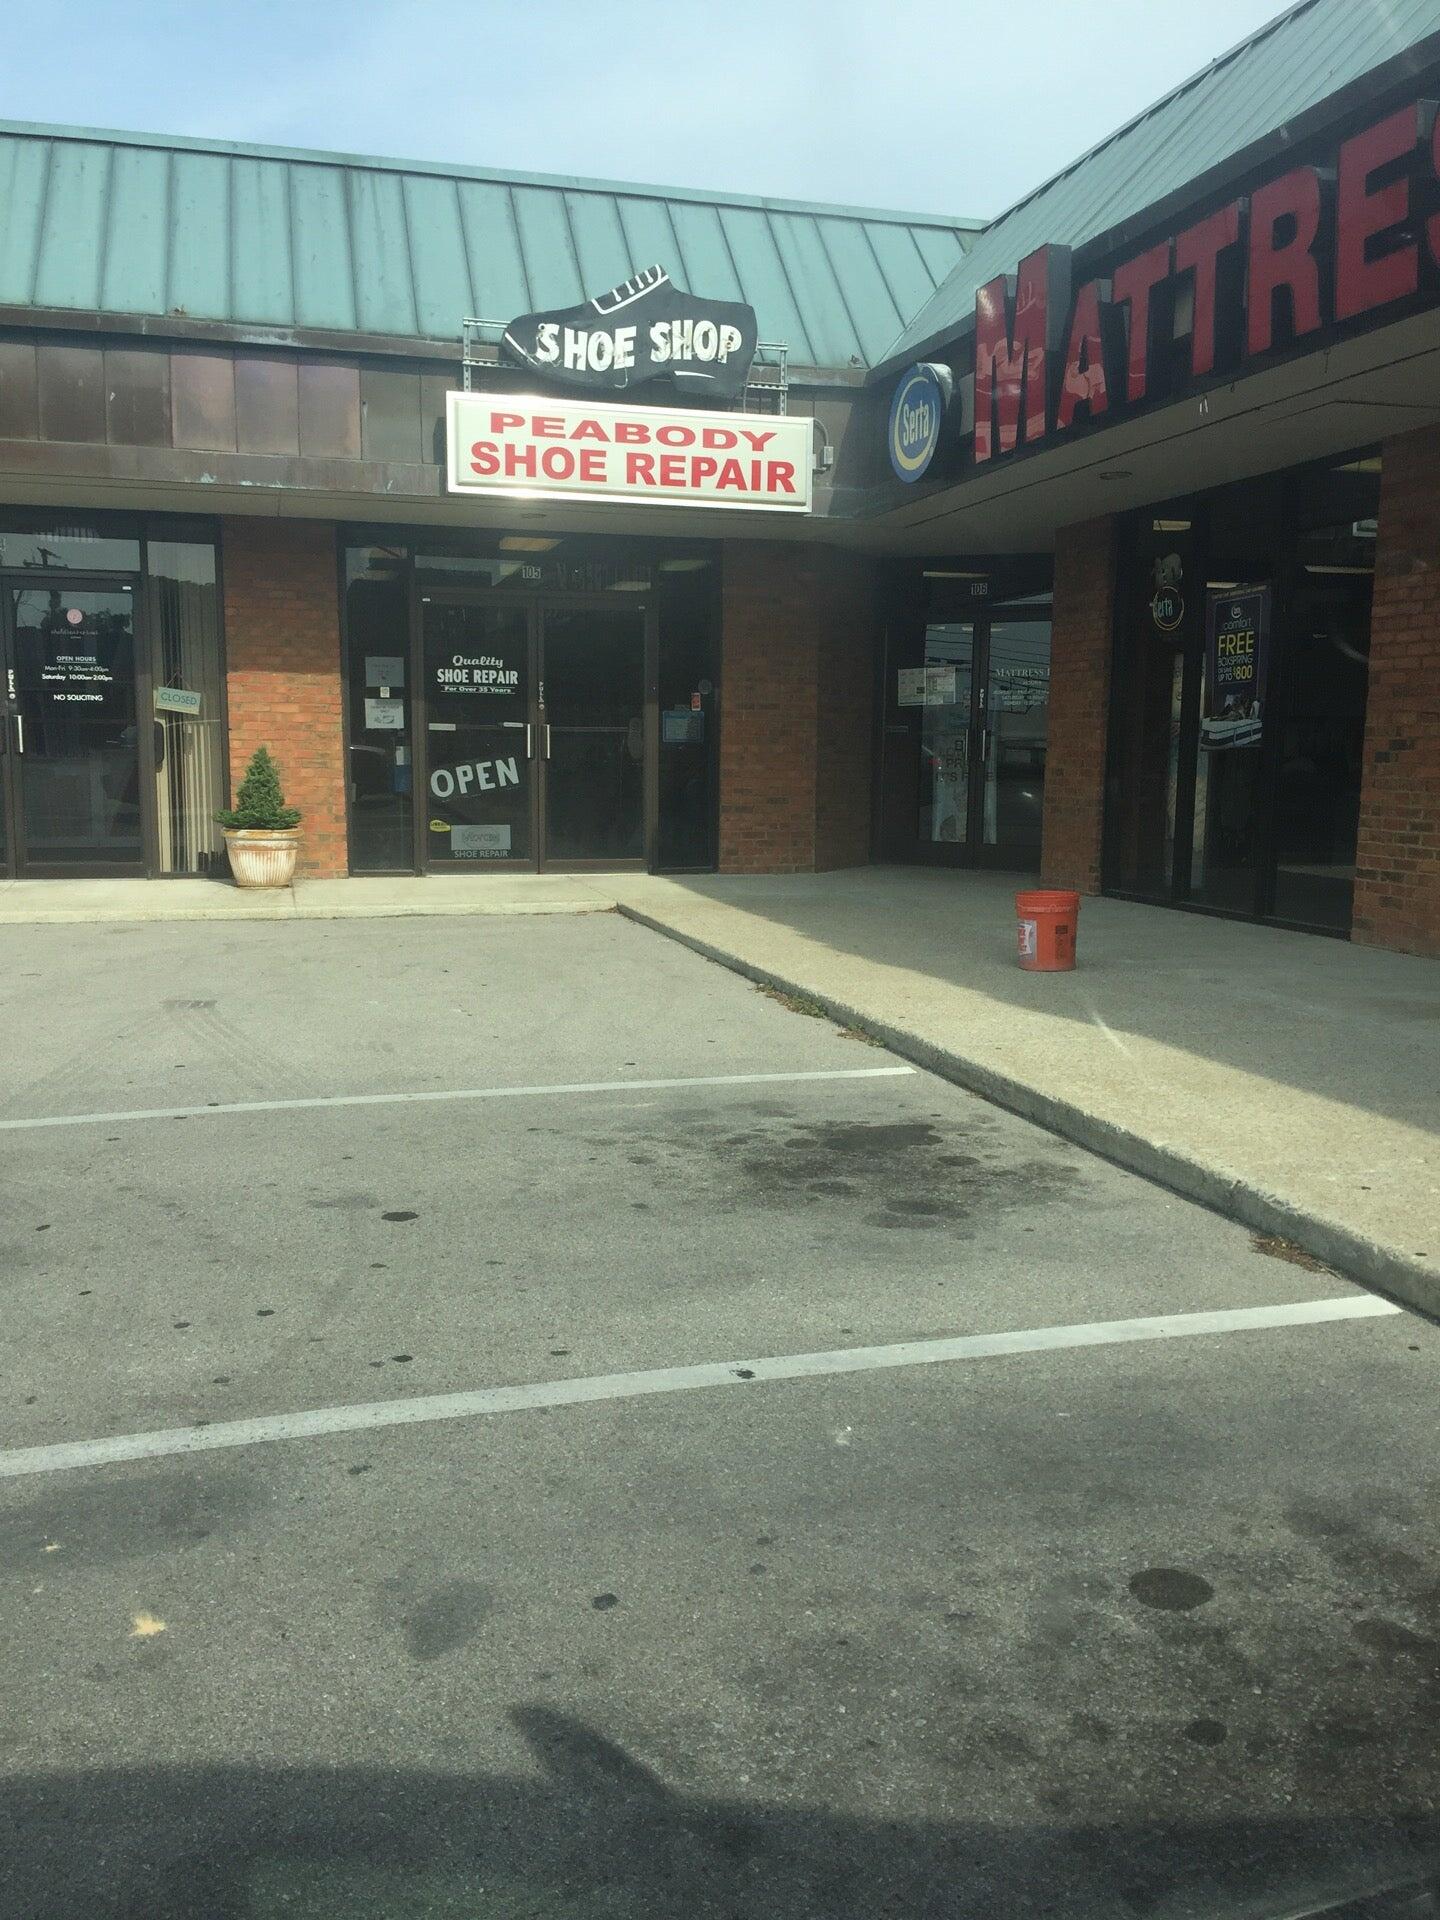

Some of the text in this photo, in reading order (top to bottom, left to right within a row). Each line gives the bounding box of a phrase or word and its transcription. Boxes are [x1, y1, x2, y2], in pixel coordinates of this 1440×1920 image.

[974, 103, 1440, 464] MATTRE
[535, 319, 742, 372] SHOE SHOP
[903, 399, 929, 447] Serta
[490, 412, 778, 452] PEABODY
[470, 441, 796, 493] SHOE REPAIR
[522, 565, 542, 579] 105
[1218, 630, 1255, 657] FREE
[452, 654, 504, 669] Quality
[41, 673, 67, 682] Saturday
[436, 668, 519, 685] SHOE REPAIR
[995, 668, 1044, 677] MATTRESS
[66, 694, 104, 702] SOLICITING
[160, 691, 198, 706] CLOSED
[430, 757, 520, 798] OPEN
[454, 850, 509, 858] SHOE REPAIR
